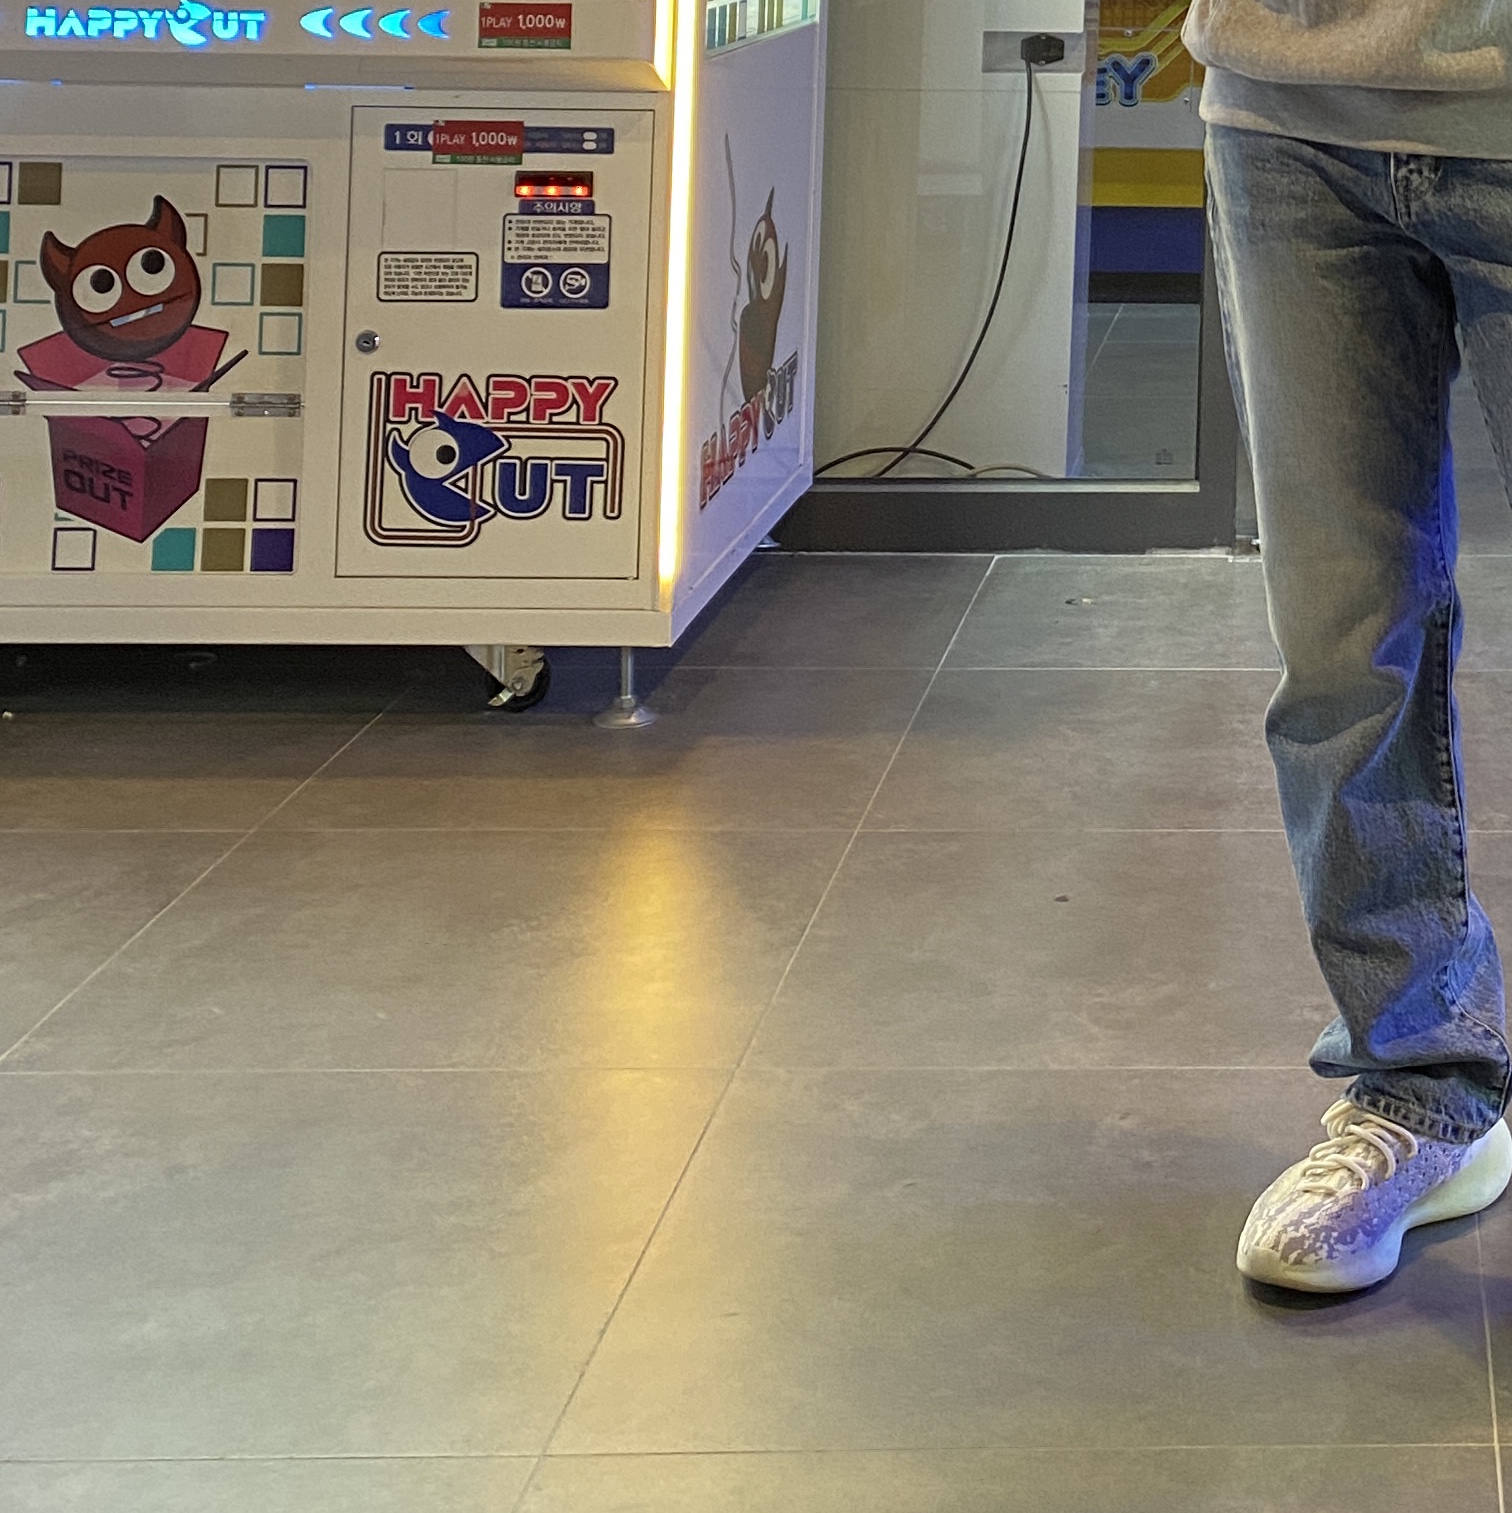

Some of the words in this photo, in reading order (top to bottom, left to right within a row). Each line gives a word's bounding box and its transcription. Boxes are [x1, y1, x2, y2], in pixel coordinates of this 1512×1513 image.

[25, 6, 165, 39] HAPPY
[481, 16, 512, 29] 1PLAY
[435, 133, 465, 145] 1PLAY
[388, 374, 618, 426] HAPPY
[62, 449, 133, 488] PRIZE
[62, 469, 134, 511] OUT
